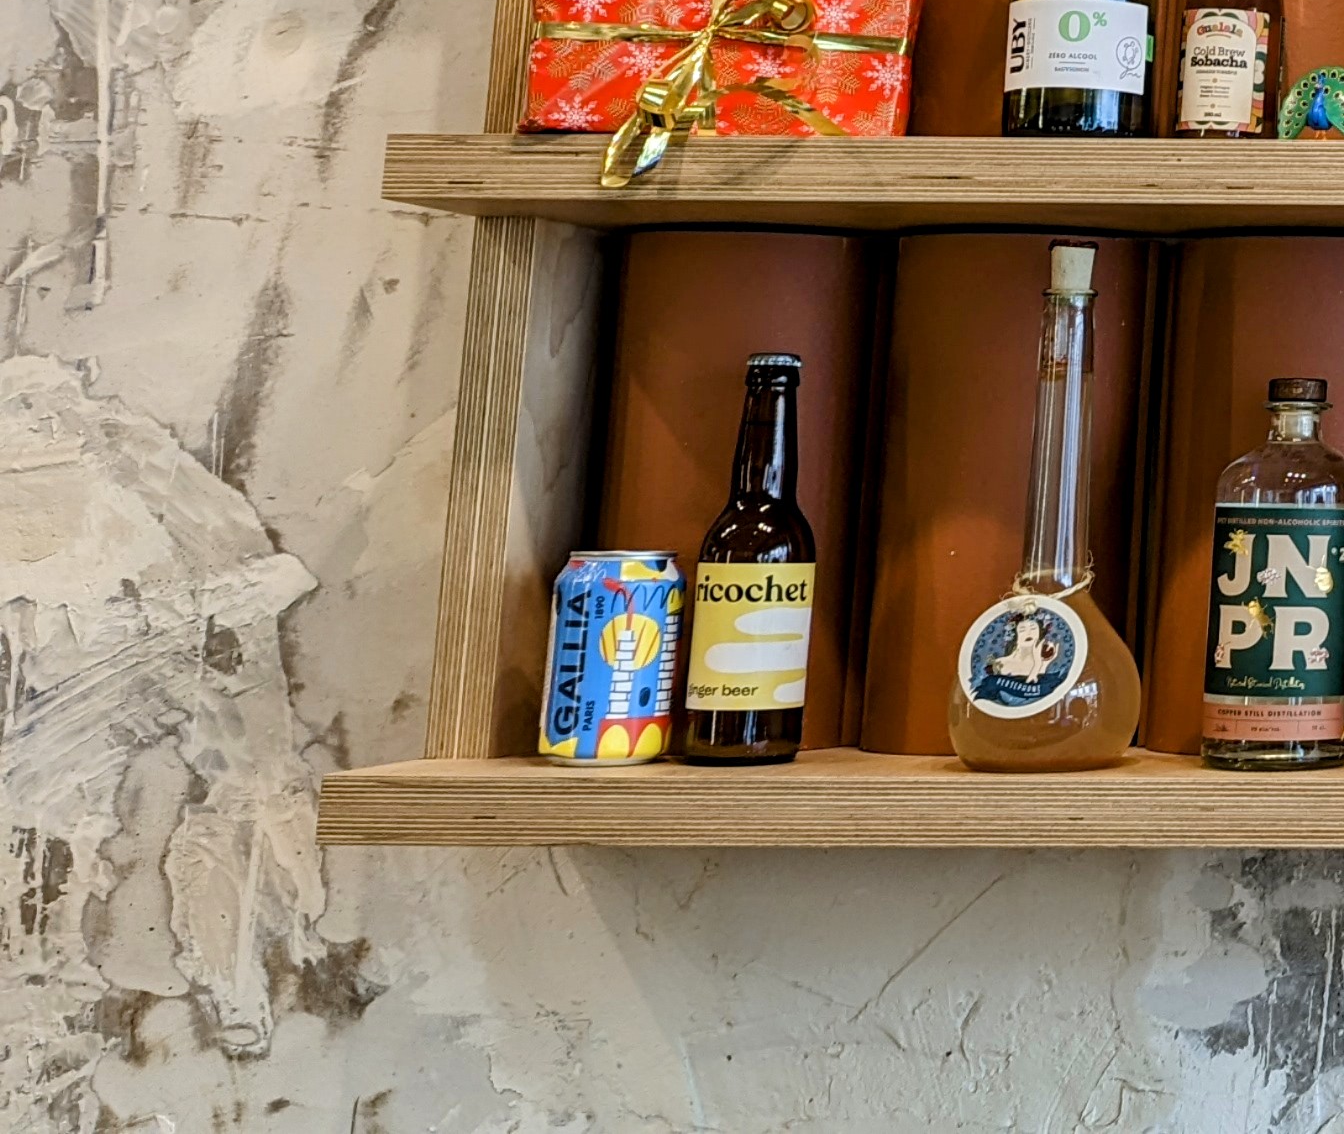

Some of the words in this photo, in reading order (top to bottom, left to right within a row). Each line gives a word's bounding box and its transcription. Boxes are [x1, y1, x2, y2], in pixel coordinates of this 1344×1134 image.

[1009, 18, 1027, 75] UBY
[1068, 52, 1098, 61] ALCOOL
[1193, 45, 1216, 57] Cold
[1217, 46, 1246, 58] Brew
[1190, 55, 1248, 69] Sobacha
[1258, 518, 1321, 526] NON-ALCOHOLIC
[1217, 533, 1332, 599] JN
[696, 574, 808, 603] ricochet
[594, 594, 606, 619] 1890
[1216, 604, 1331, 670] PR
[553, 589, 592, 736] GALLIA
[721, 683, 759, 698] beer
[582, 700, 596, 732] PARIS
[1217, 708, 1242, 716] COPPER
[1244, 709, 1264, 717] STILL
[1267, 709, 1322, 718] DISTILLATION
